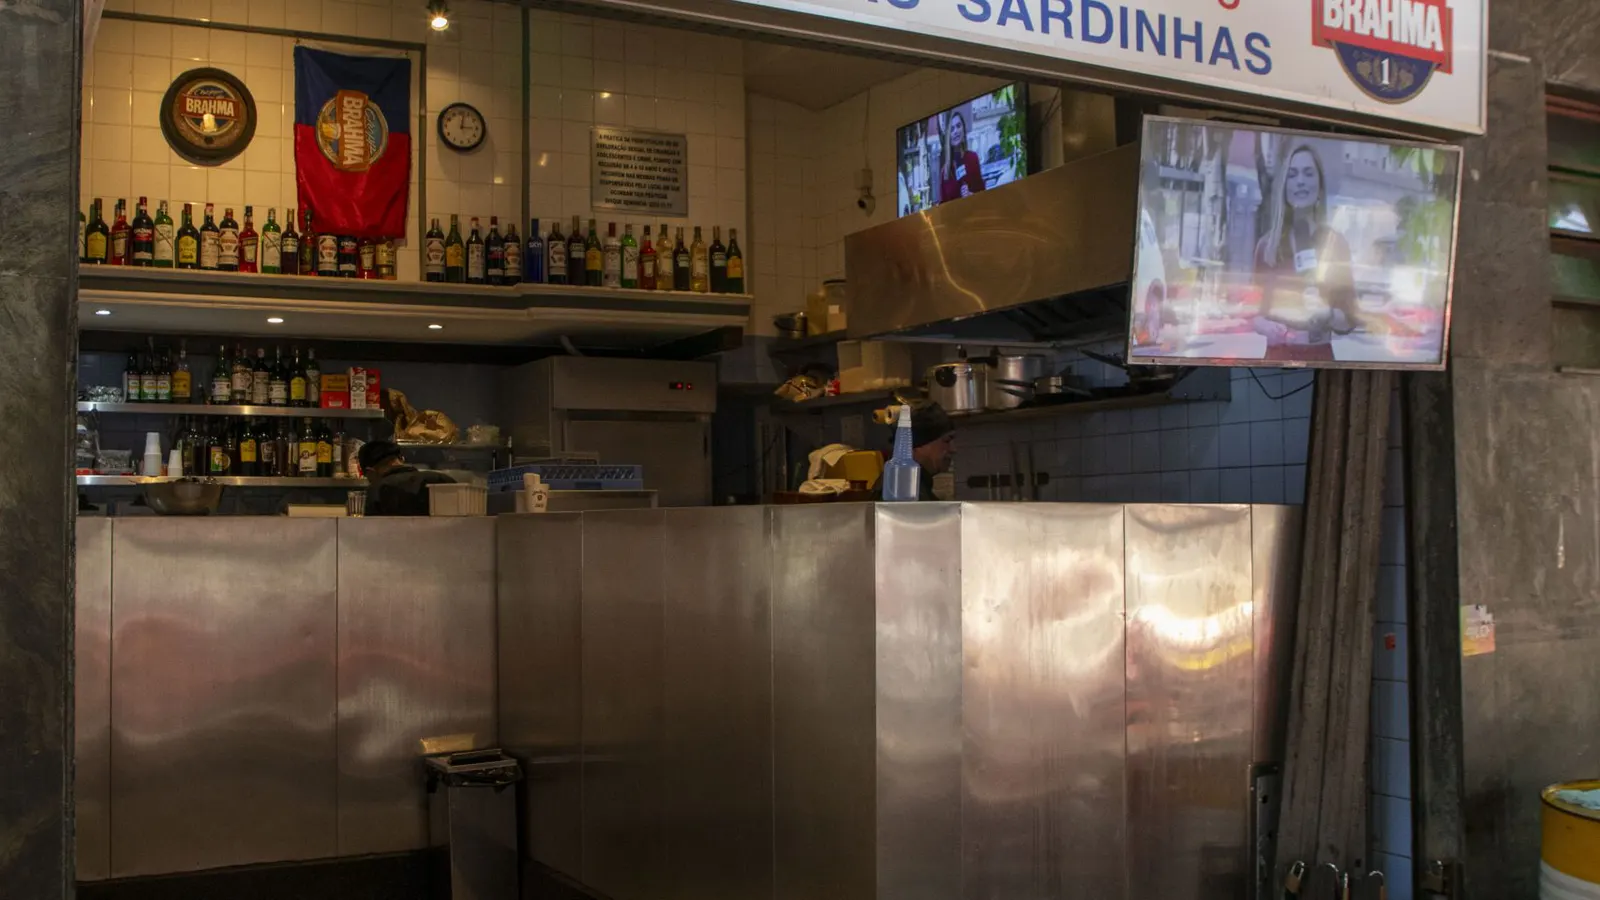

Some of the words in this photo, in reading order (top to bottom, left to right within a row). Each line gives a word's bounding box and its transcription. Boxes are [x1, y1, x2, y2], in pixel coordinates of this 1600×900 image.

[1324, 0, 1443, 51] BRAHMA
[1381, 58, 1390, 85] 1
[185, 97, 235, 117] BRAHMA
[342, 96, 365, 165] BRAHMA
